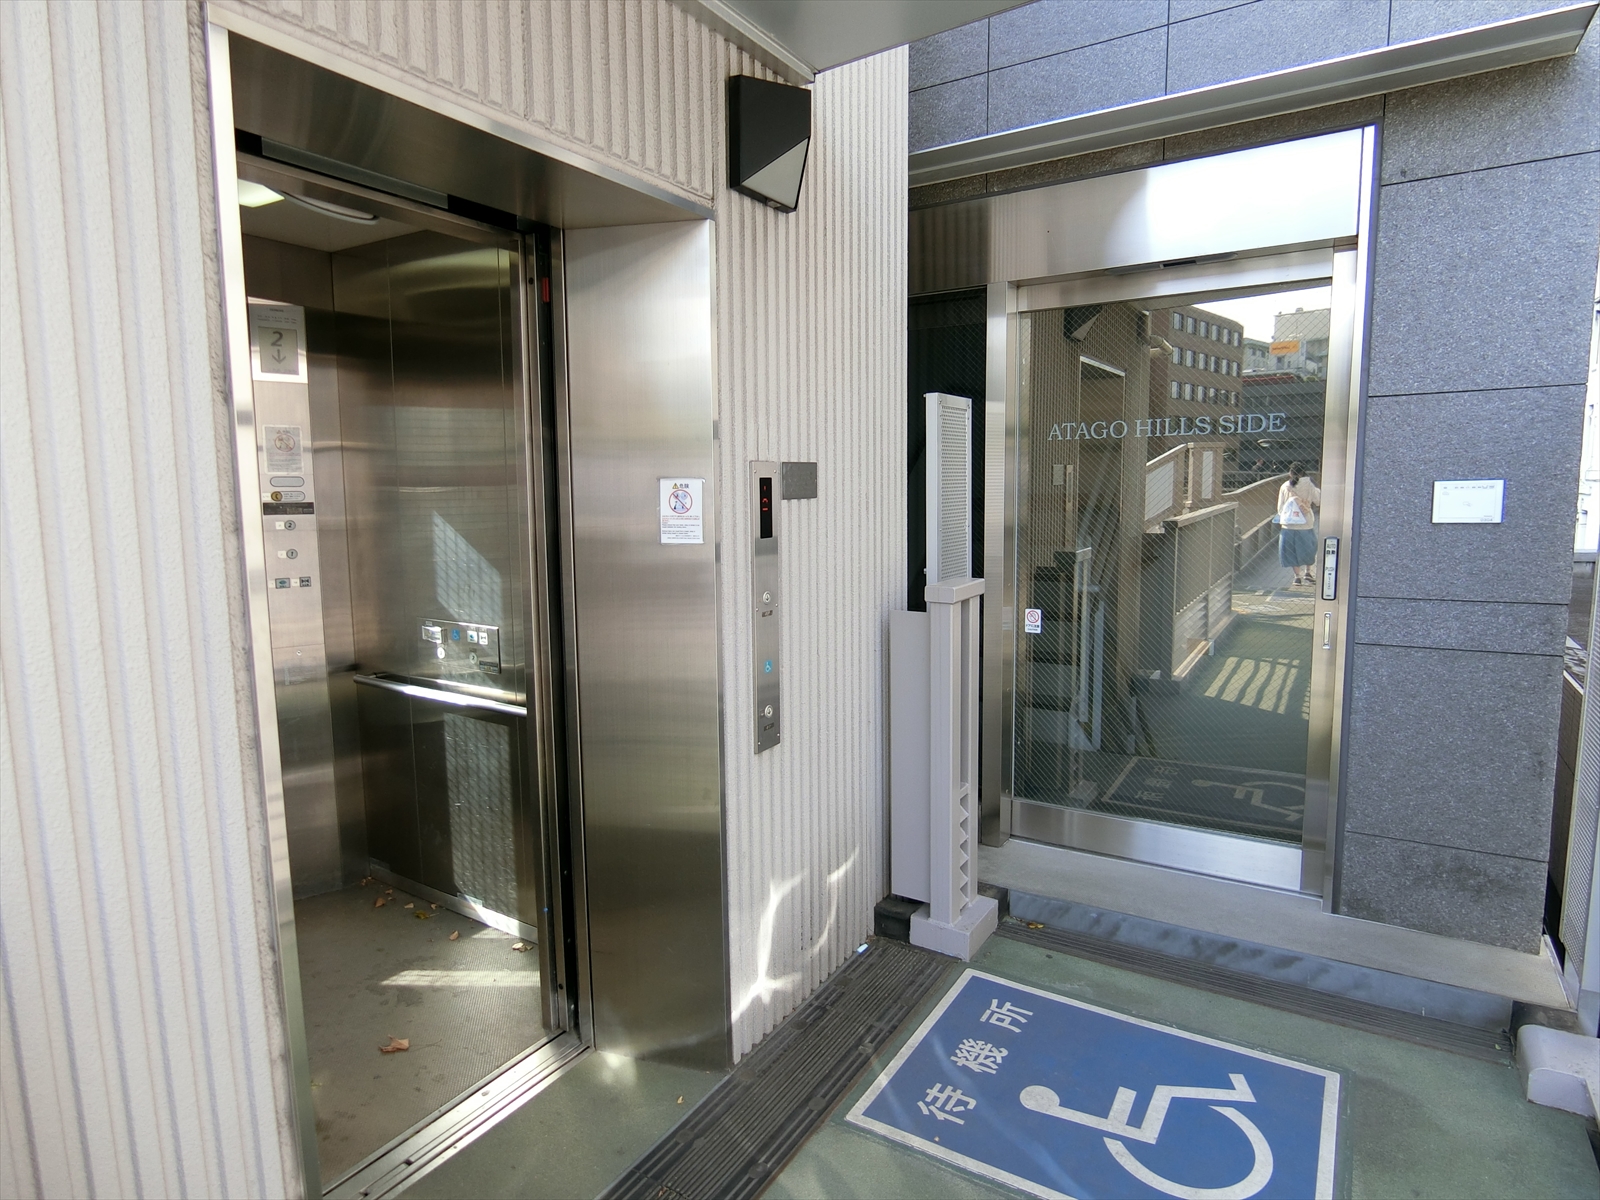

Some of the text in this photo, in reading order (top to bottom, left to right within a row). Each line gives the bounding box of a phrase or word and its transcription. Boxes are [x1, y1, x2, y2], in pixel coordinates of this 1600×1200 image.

[271, 331, 283, 347] 2
[1049, 412, 1287, 441] ATAGO HILLS SIDE
[916, 998, 1034, 1126] 待機所
